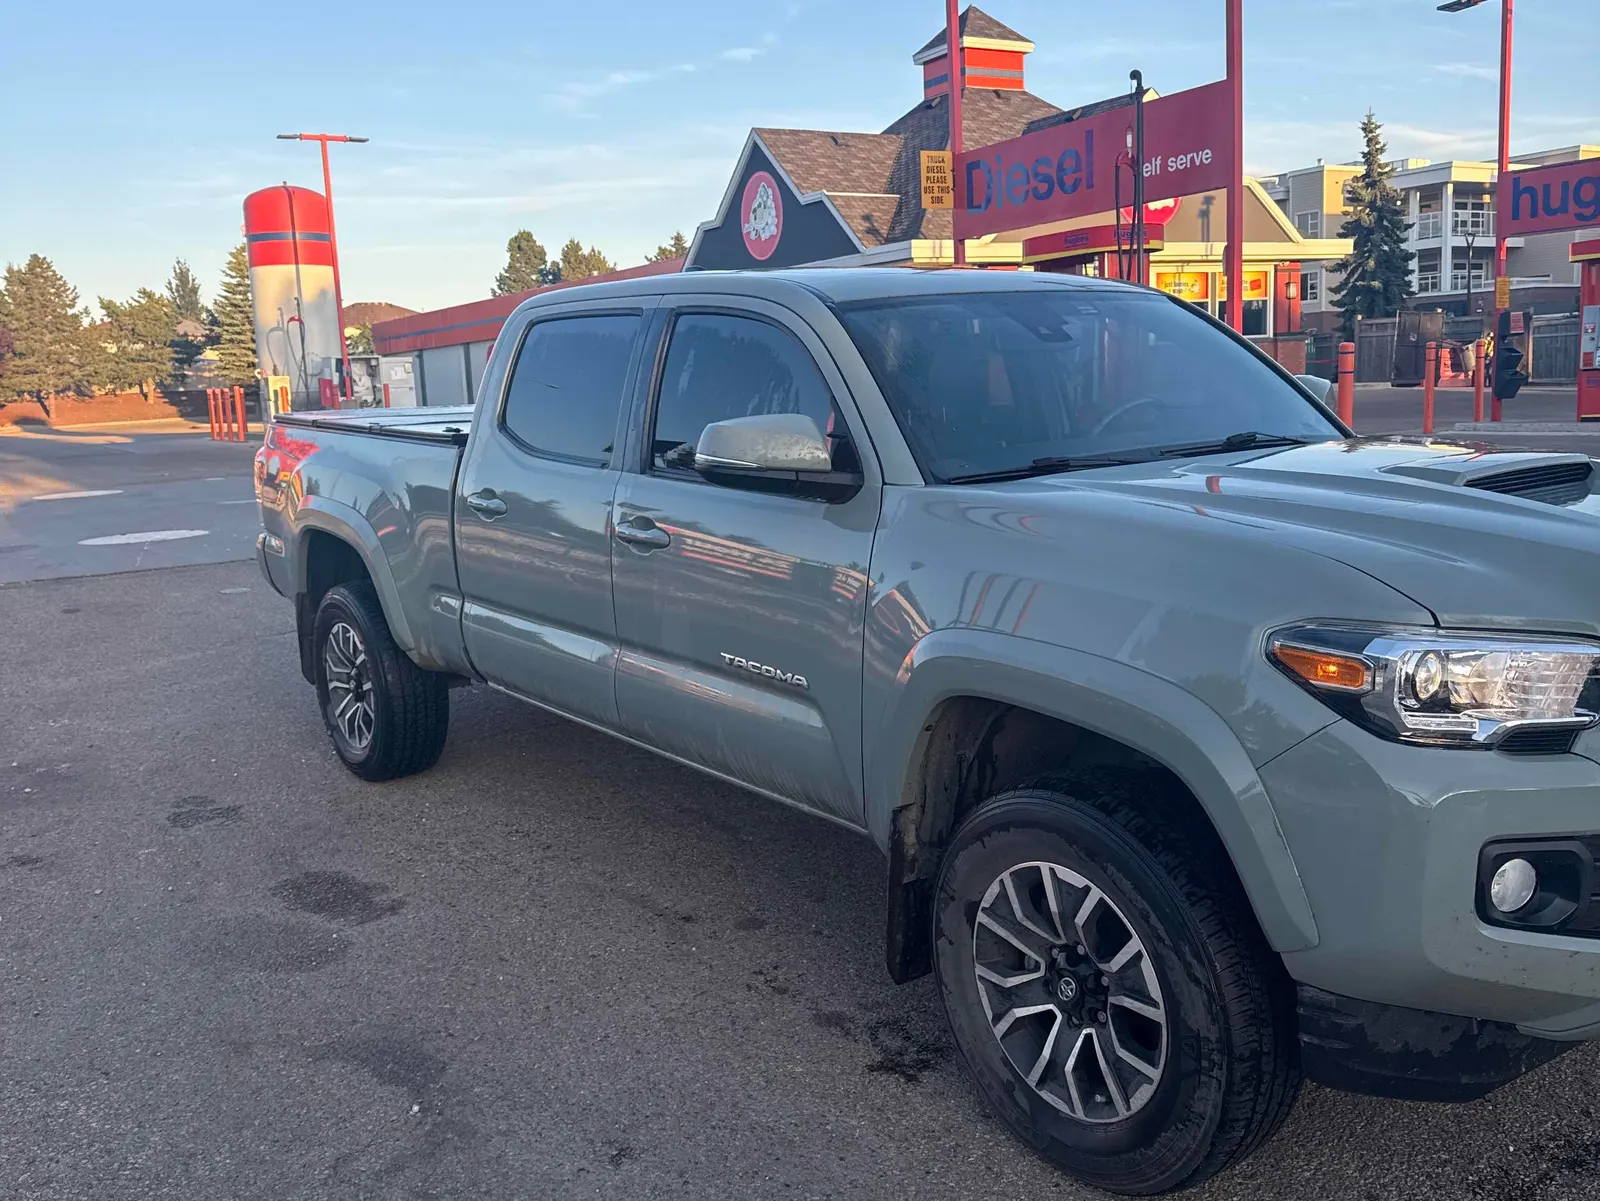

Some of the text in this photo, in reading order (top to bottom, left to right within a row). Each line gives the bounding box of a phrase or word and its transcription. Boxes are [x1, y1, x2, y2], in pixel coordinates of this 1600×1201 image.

[926, 155, 946, 164] TRUCK
[1142, 148, 1212, 177] elf serve
[926, 165, 946, 174] DIESEL
[966, 129, 1094, 215] Diesel
[925, 175, 947, 184] PLEASE
[923, 186, 951, 194] USE THIS
[930, 196, 945, 204] SIDE
[1511, 176, 1600, 222] hug
[720, 652, 809, 689] TACOMA
